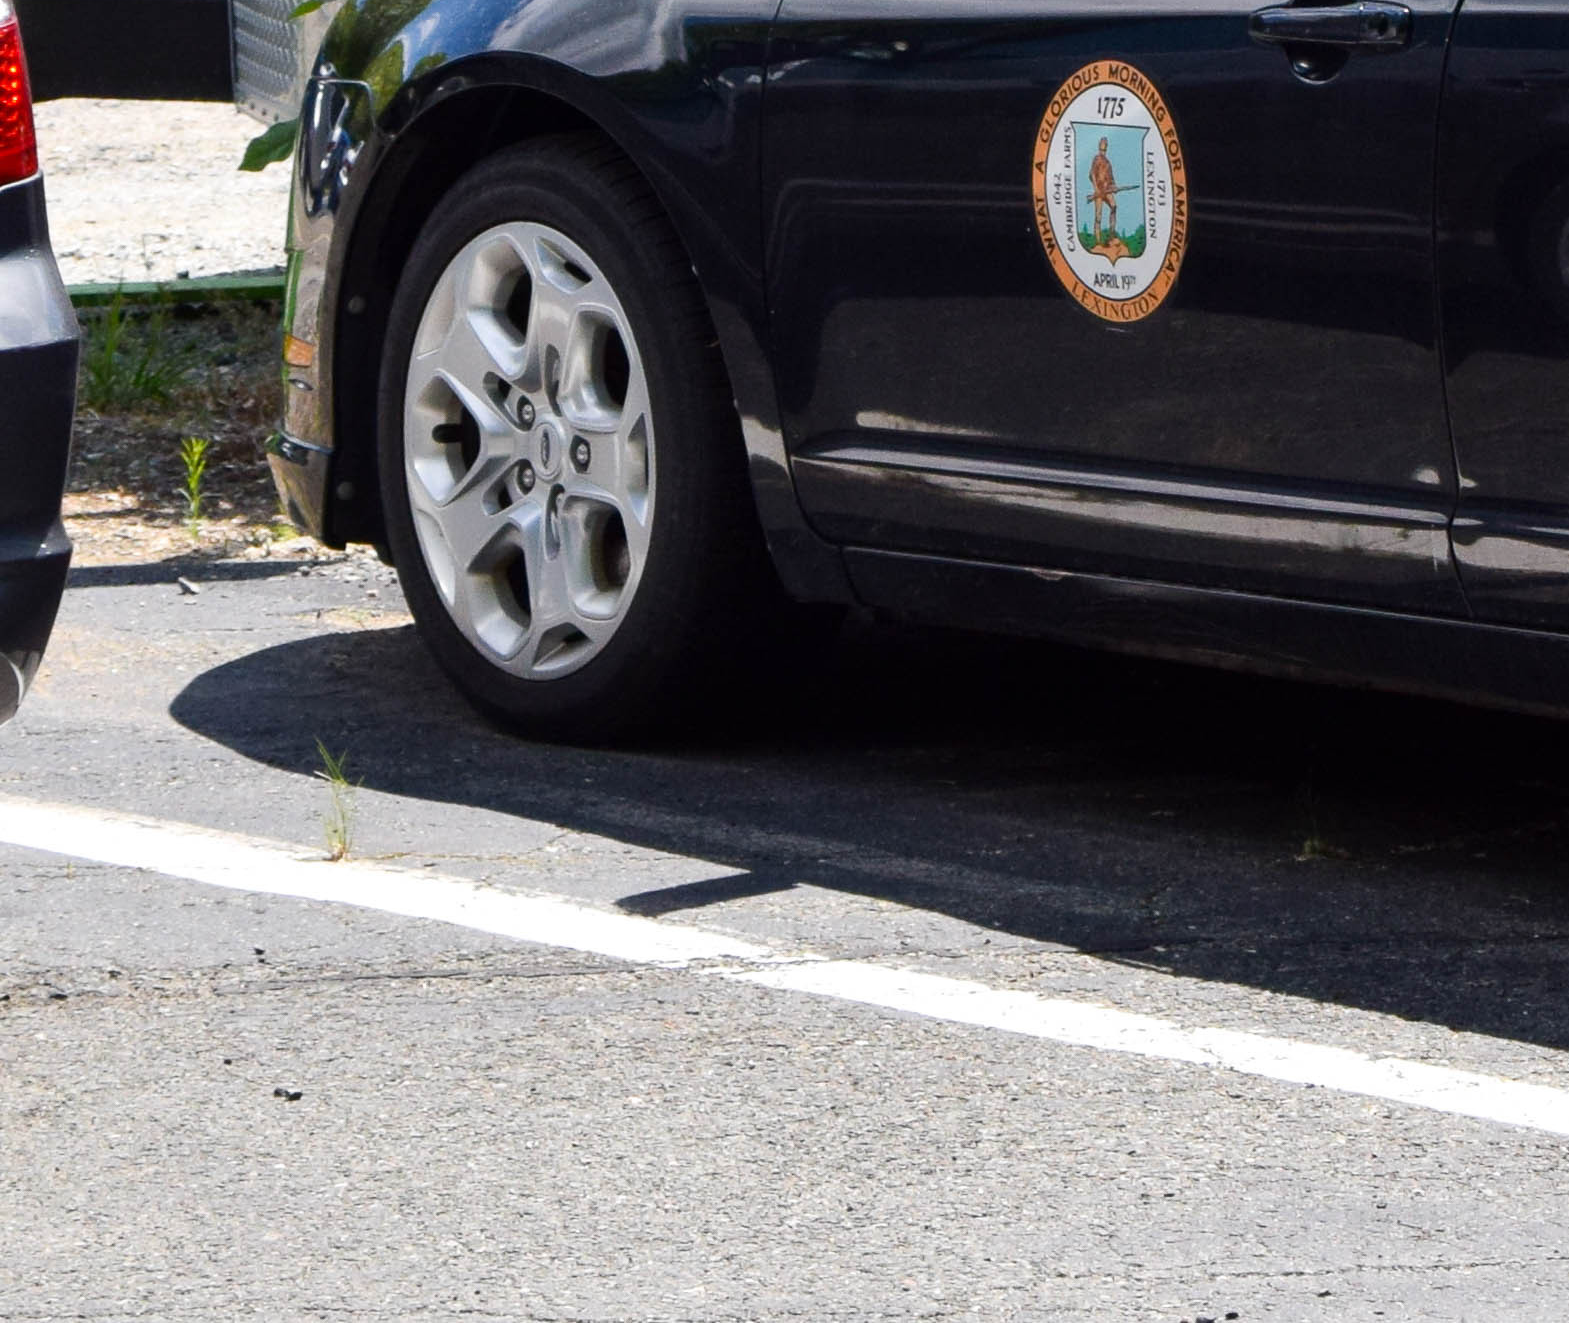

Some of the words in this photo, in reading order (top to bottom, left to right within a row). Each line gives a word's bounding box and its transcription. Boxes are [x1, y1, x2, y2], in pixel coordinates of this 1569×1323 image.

[1039, 65, 1100, 144] GLORIOUS
[1097, 96, 1126, 119] 1775
[1108, 63, 1166, 123] MORNING
[1034, 160, 1045, 174] A
[1063, 126, 1073, 168] FARMS
[1164, 129, 1182, 172] FOR
[1064, 178, 1076, 252] CAMBRIDGE
[1146, 151, 1158, 239] LEXINGTON
[1071, 280, 1159, 320] LEXINGTON
[1093, 273, 1120, 289] APRIL
